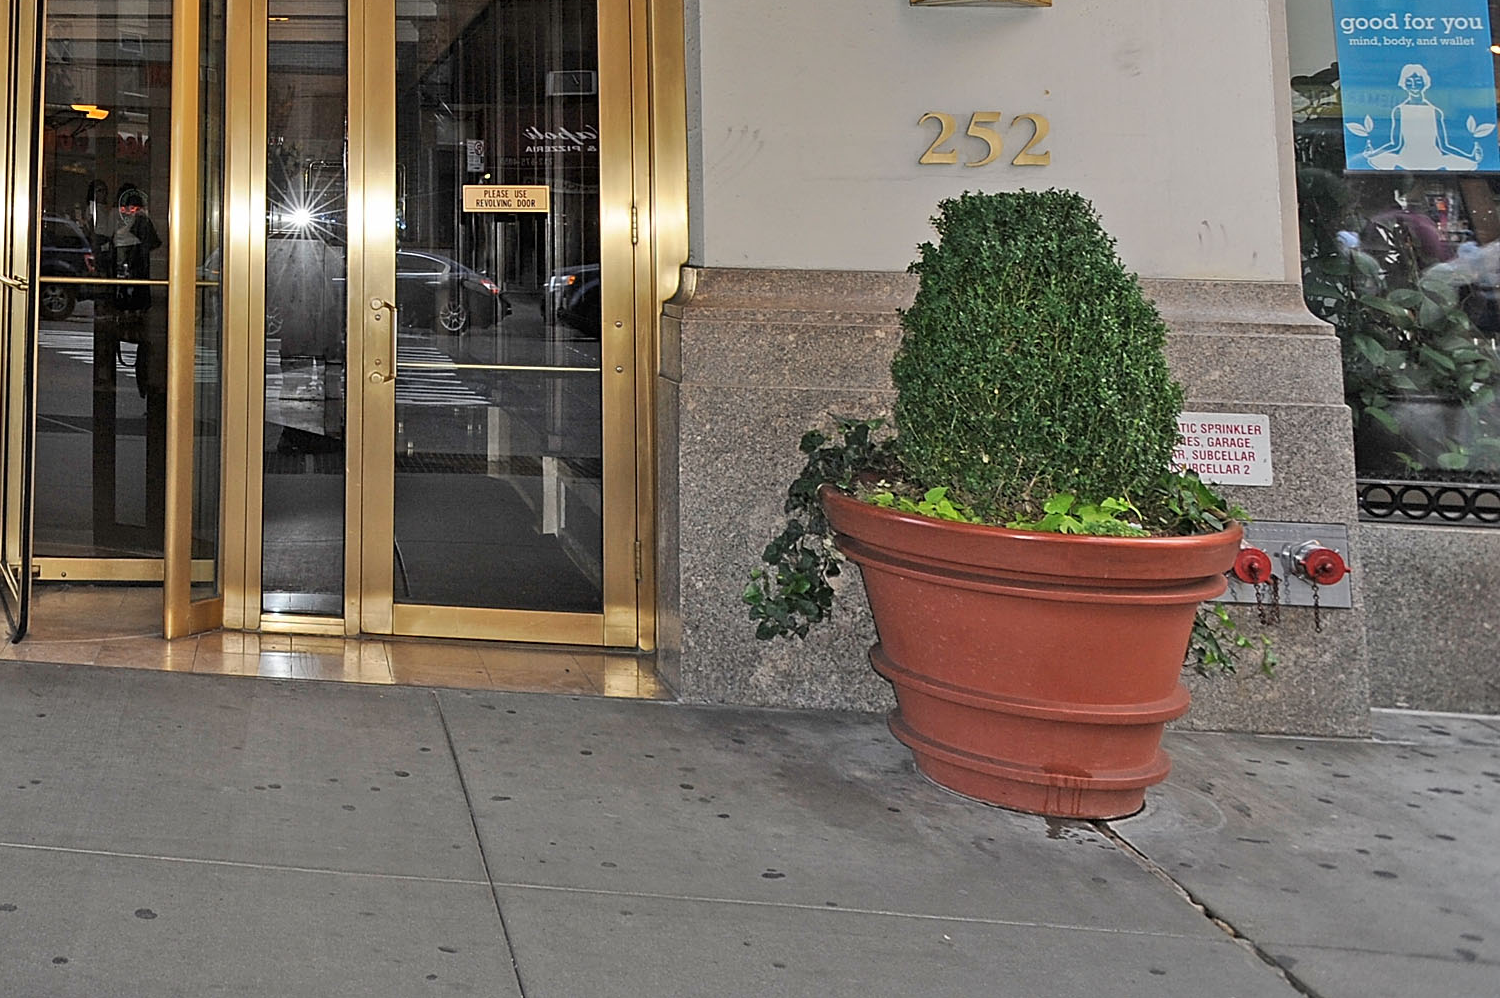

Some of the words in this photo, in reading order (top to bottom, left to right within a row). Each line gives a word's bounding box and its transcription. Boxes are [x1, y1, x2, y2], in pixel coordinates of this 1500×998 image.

[1340, 13, 1398, 34] good
[1404, 13, 1436, 30] for
[1440, 16, 1484, 34] you
[1349, 36, 1382, 46] mind,
[1383, 36, 1415, 47] body,
[1416, 36, 1437, 46] and
[1440, 36, 1475, 46] wallet
[917, 111, 1050, 167] 252
[483, 189, 509, 198] PLEASE
[514, 189, 527, 198] USE
[475, 199, 512, 208] REVOLVING
[517, 199, 536, 208] DOOR
[1200, 423, 1262, 435] SPRINKLER
[1207, 437, 1254, 449] GARAGE,
[1192, 450, 1256, 462] SUBCELLAR
[1243, 464, 1251, 475] 2
